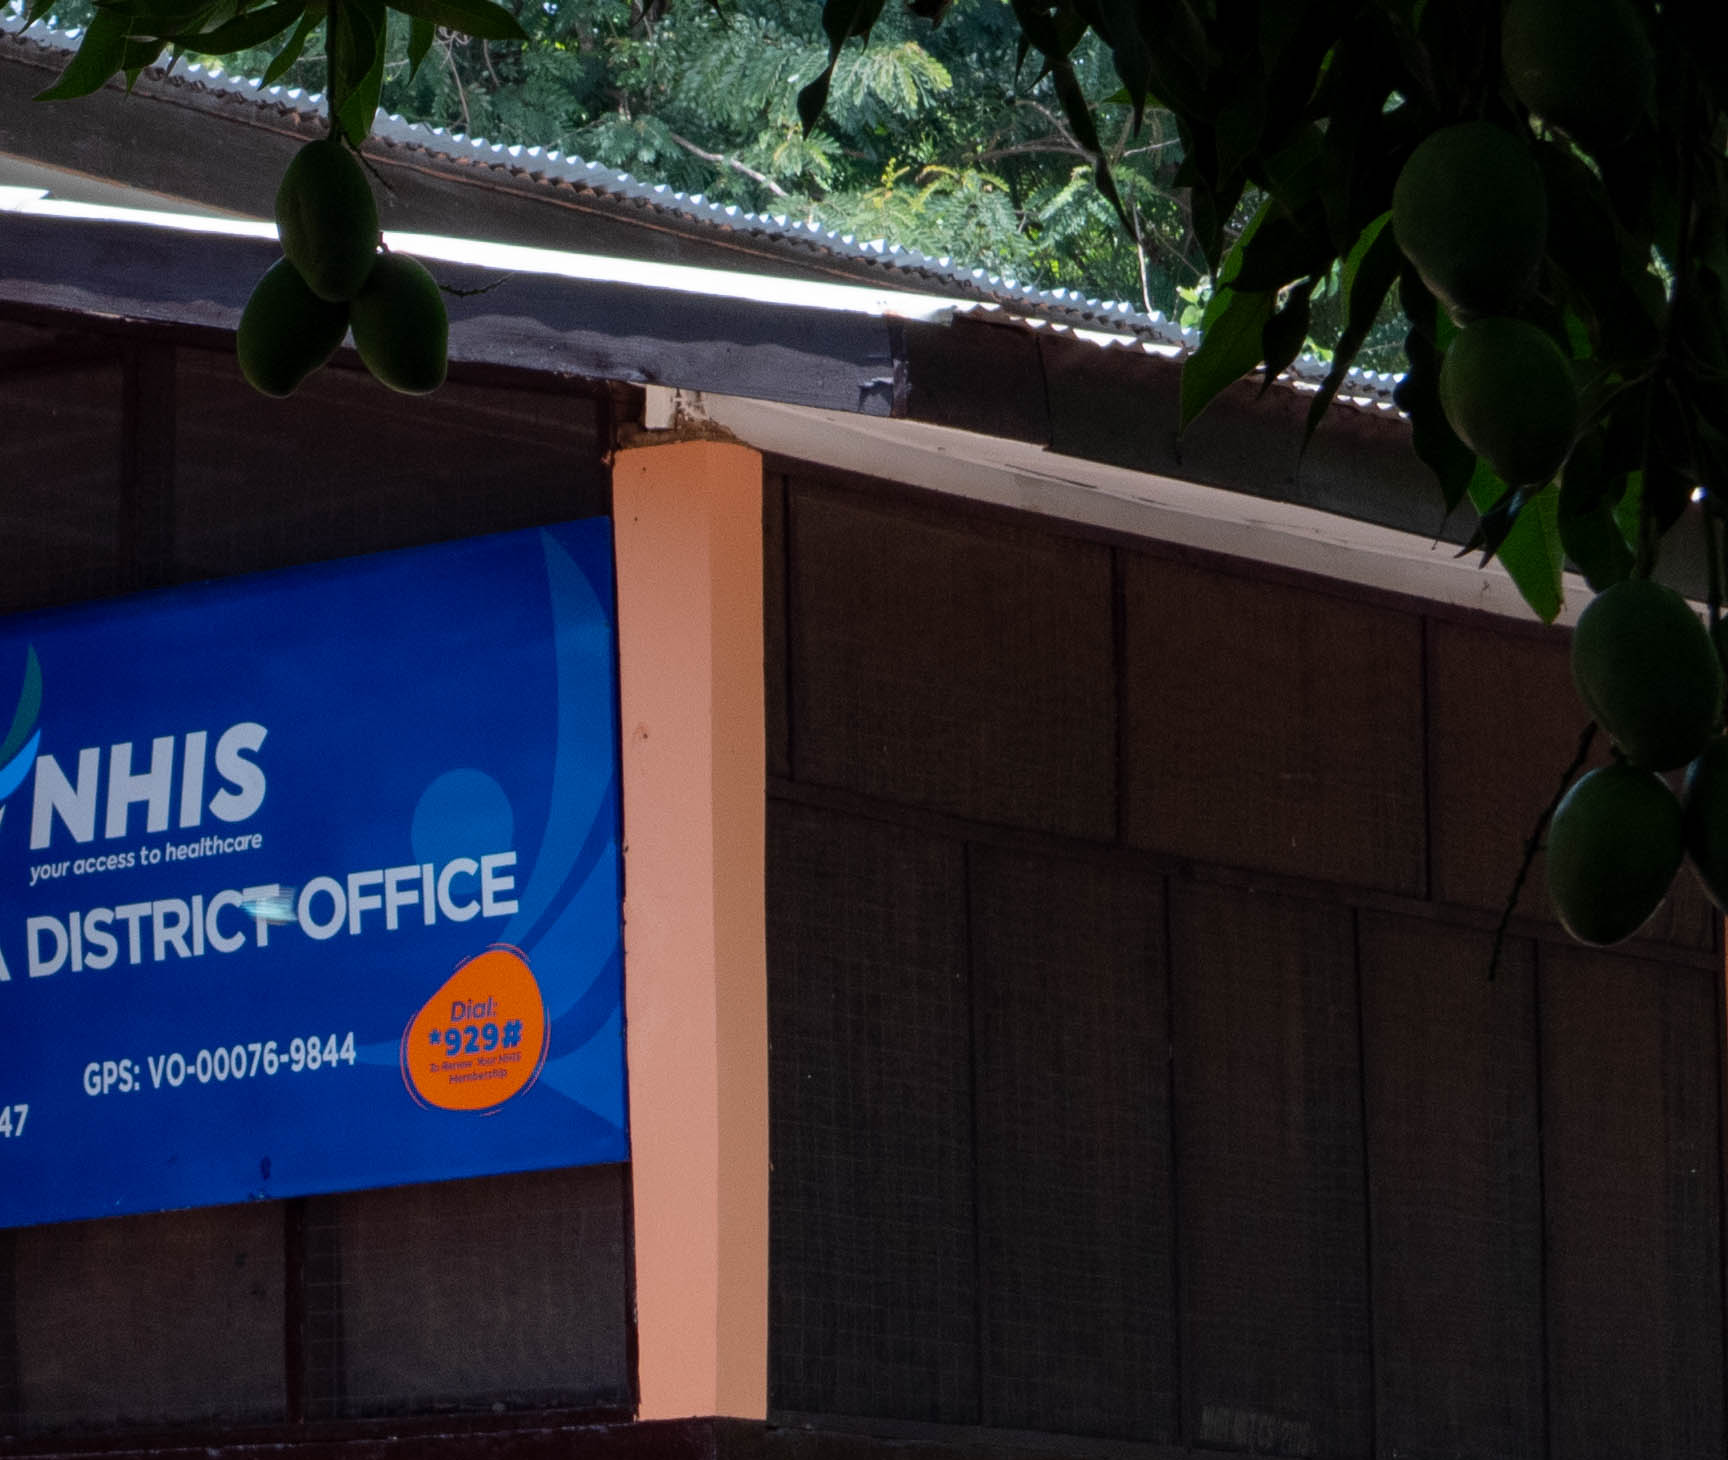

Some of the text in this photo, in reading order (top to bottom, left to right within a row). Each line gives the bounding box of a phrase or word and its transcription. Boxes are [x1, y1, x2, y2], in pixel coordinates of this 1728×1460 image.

[30, 722, 268, 850] NHIS
[29, 833, 263, 887] your access to healthcare
[25, 884, 281, 977] DISTRICT
[296, 851, 519, 941] OFFICE
[451, 997, 498, 1022] Dial:
[83, 1031, 356, 1096] GPS: VO-00076-9844
